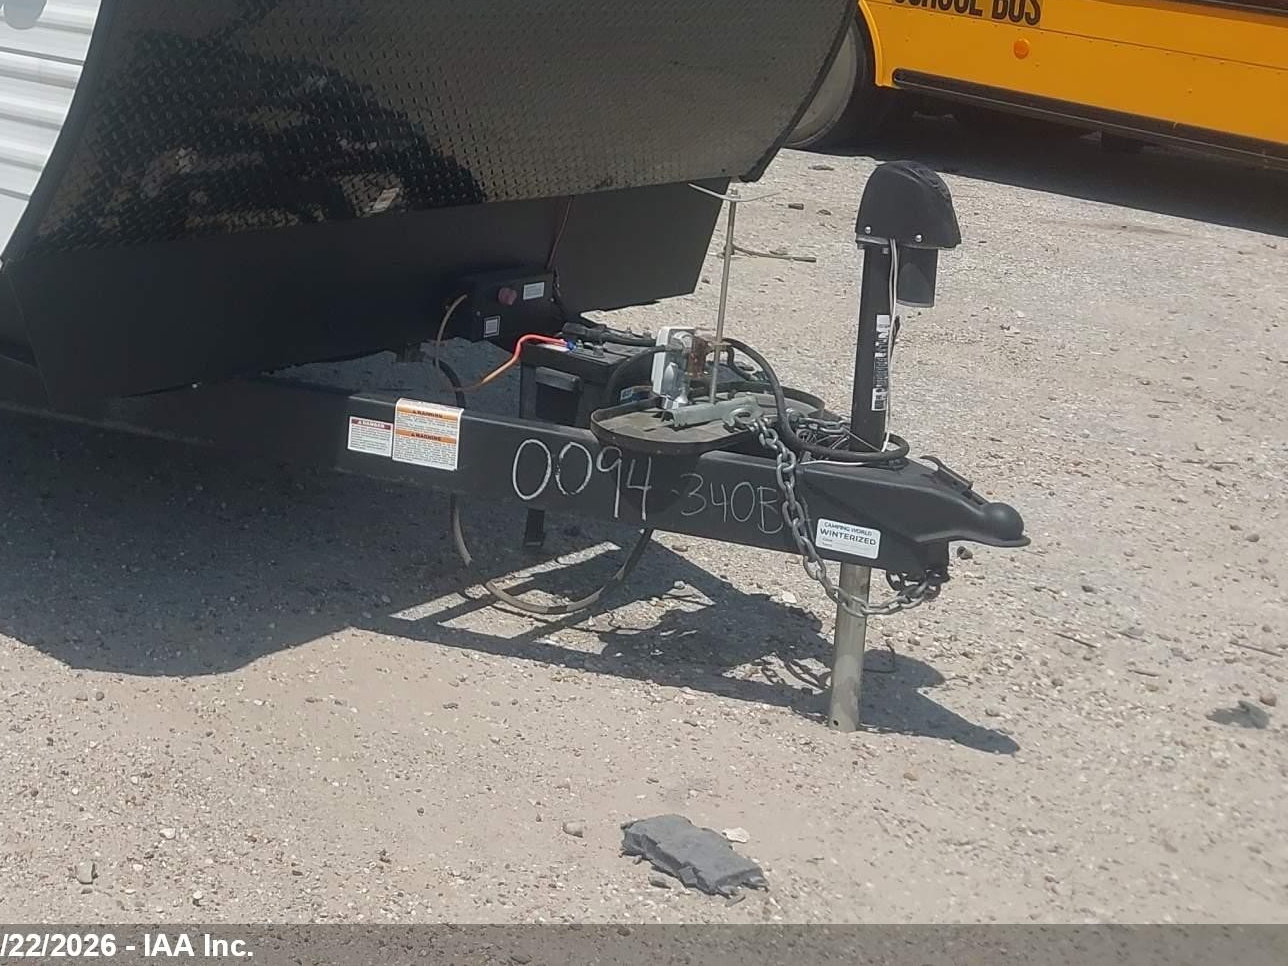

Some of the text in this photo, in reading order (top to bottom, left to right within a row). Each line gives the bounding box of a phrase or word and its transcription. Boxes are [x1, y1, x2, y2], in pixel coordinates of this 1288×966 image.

[512, 439, 652, 521] 0094
[820, 528, 876, 546] WINTERIZED
[824, 521, 873, 537] CAMPING WORLD
